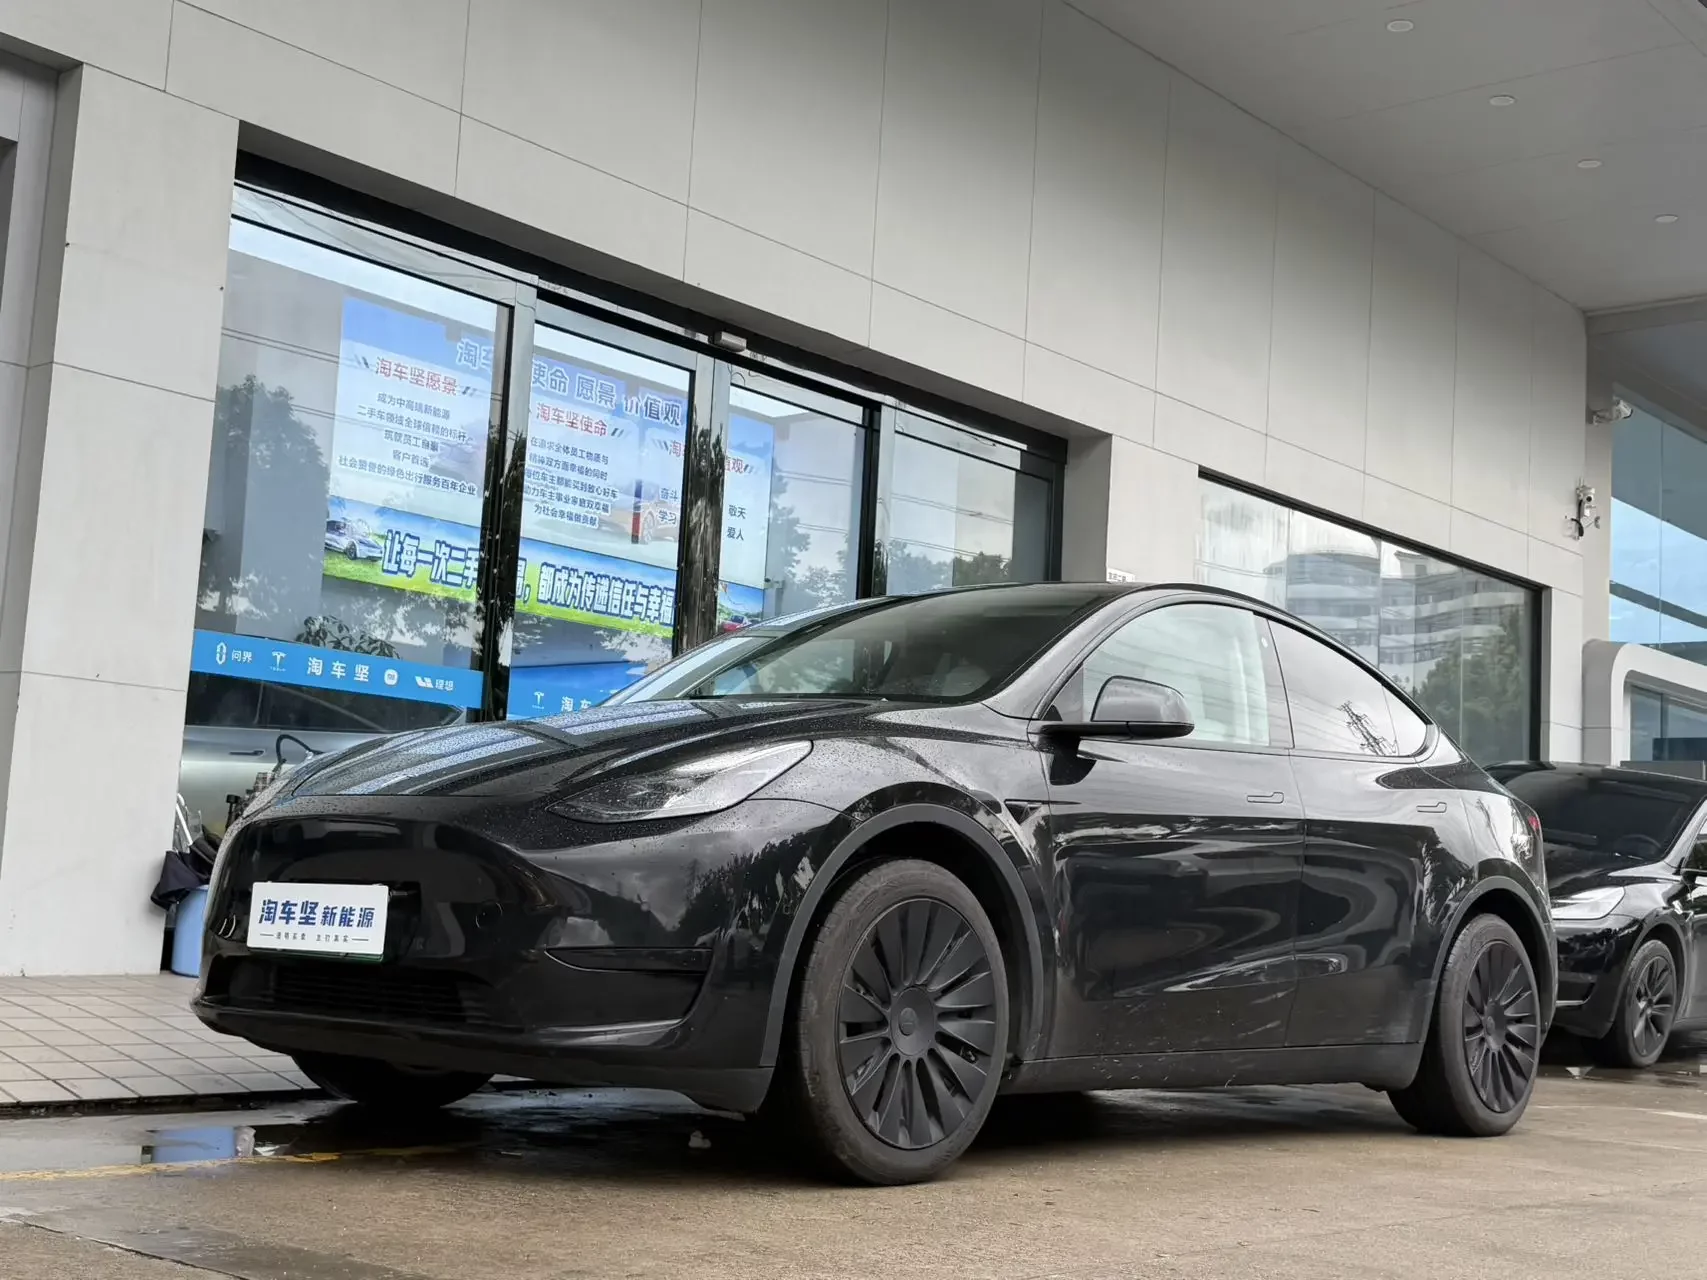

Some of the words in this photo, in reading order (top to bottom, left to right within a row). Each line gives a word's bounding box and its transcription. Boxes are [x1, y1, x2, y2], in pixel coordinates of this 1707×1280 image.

[376, 356, 457, 396] 淘车坚愿景
[377, 392, 451, 420] 成为中高端新能源
[576, 374, 617, 408] 愿景
[623, 393, 682, 427] 价值观
[536, 403, 608, 437] 淘车坚使命
[660, 487, 680, 501] 奋斗
[728, 504, 748, 520] 敬天
[657, 509, 677, 525] 学习
[726, 526, 745, 541] 爱人
[231, 648, 253, 663] 问界
[307, 657, 370, 682] 淘车坚
[258, 899, 376, 928] 淘车坚新能源
